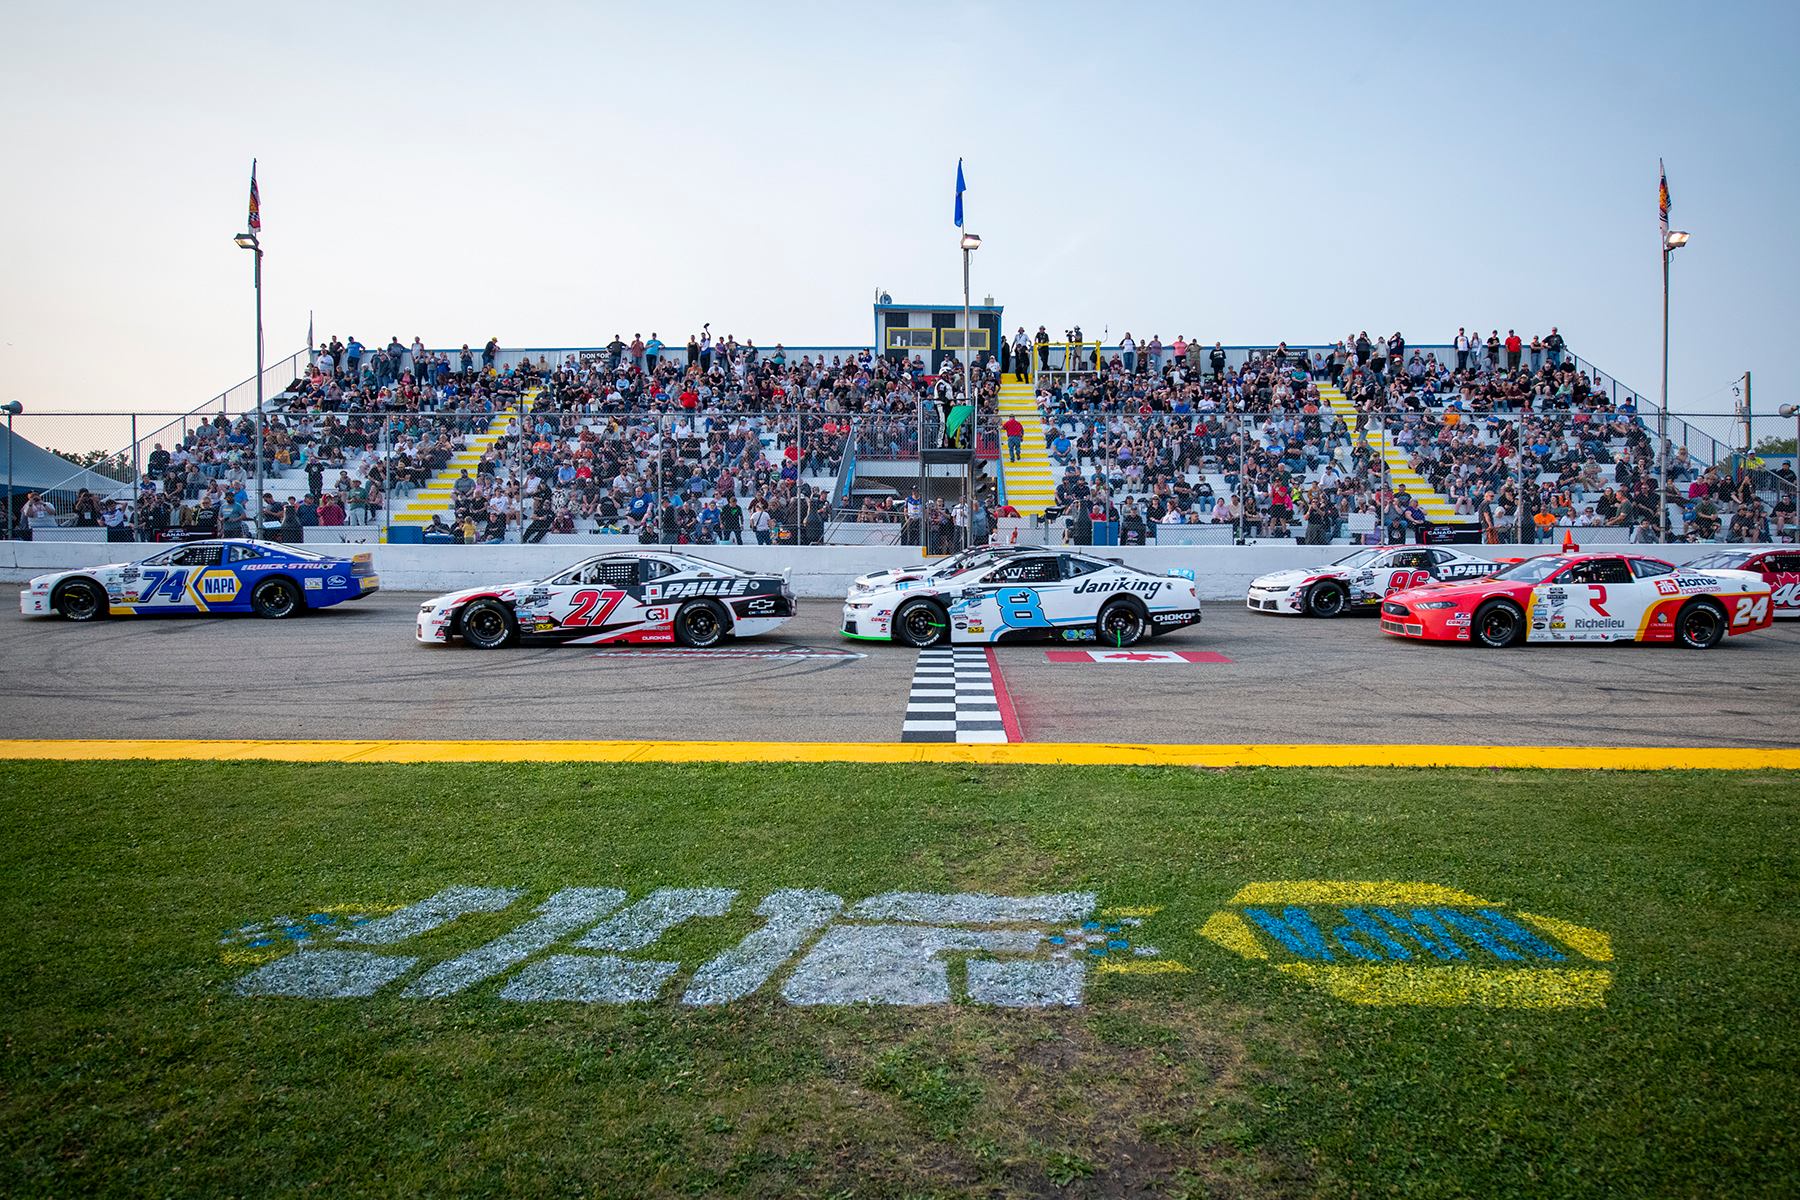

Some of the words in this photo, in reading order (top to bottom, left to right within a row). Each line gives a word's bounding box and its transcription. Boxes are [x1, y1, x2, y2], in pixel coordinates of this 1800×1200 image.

[138, 568, 189, 604] 74
[203, 578, 236, 595] NAPA
[662, 578, 750, 599] PAILLE
[1385, 570, 1431, 597] 96
[1674, 577, 1718, 588] Home
[1680, 584, 1723, 595] hardware
[995, 586, 1048, 628] 8
[1588, 584, 1612, 617] R
[1771, 583, 1800, 607] 46
[561, 588, 628, 629] 27
[1152, 612, 1192, 622] CHOKO
[1732, 596, 1769, 627] 24
[1574, 618, 1625, 629] Richelieu
